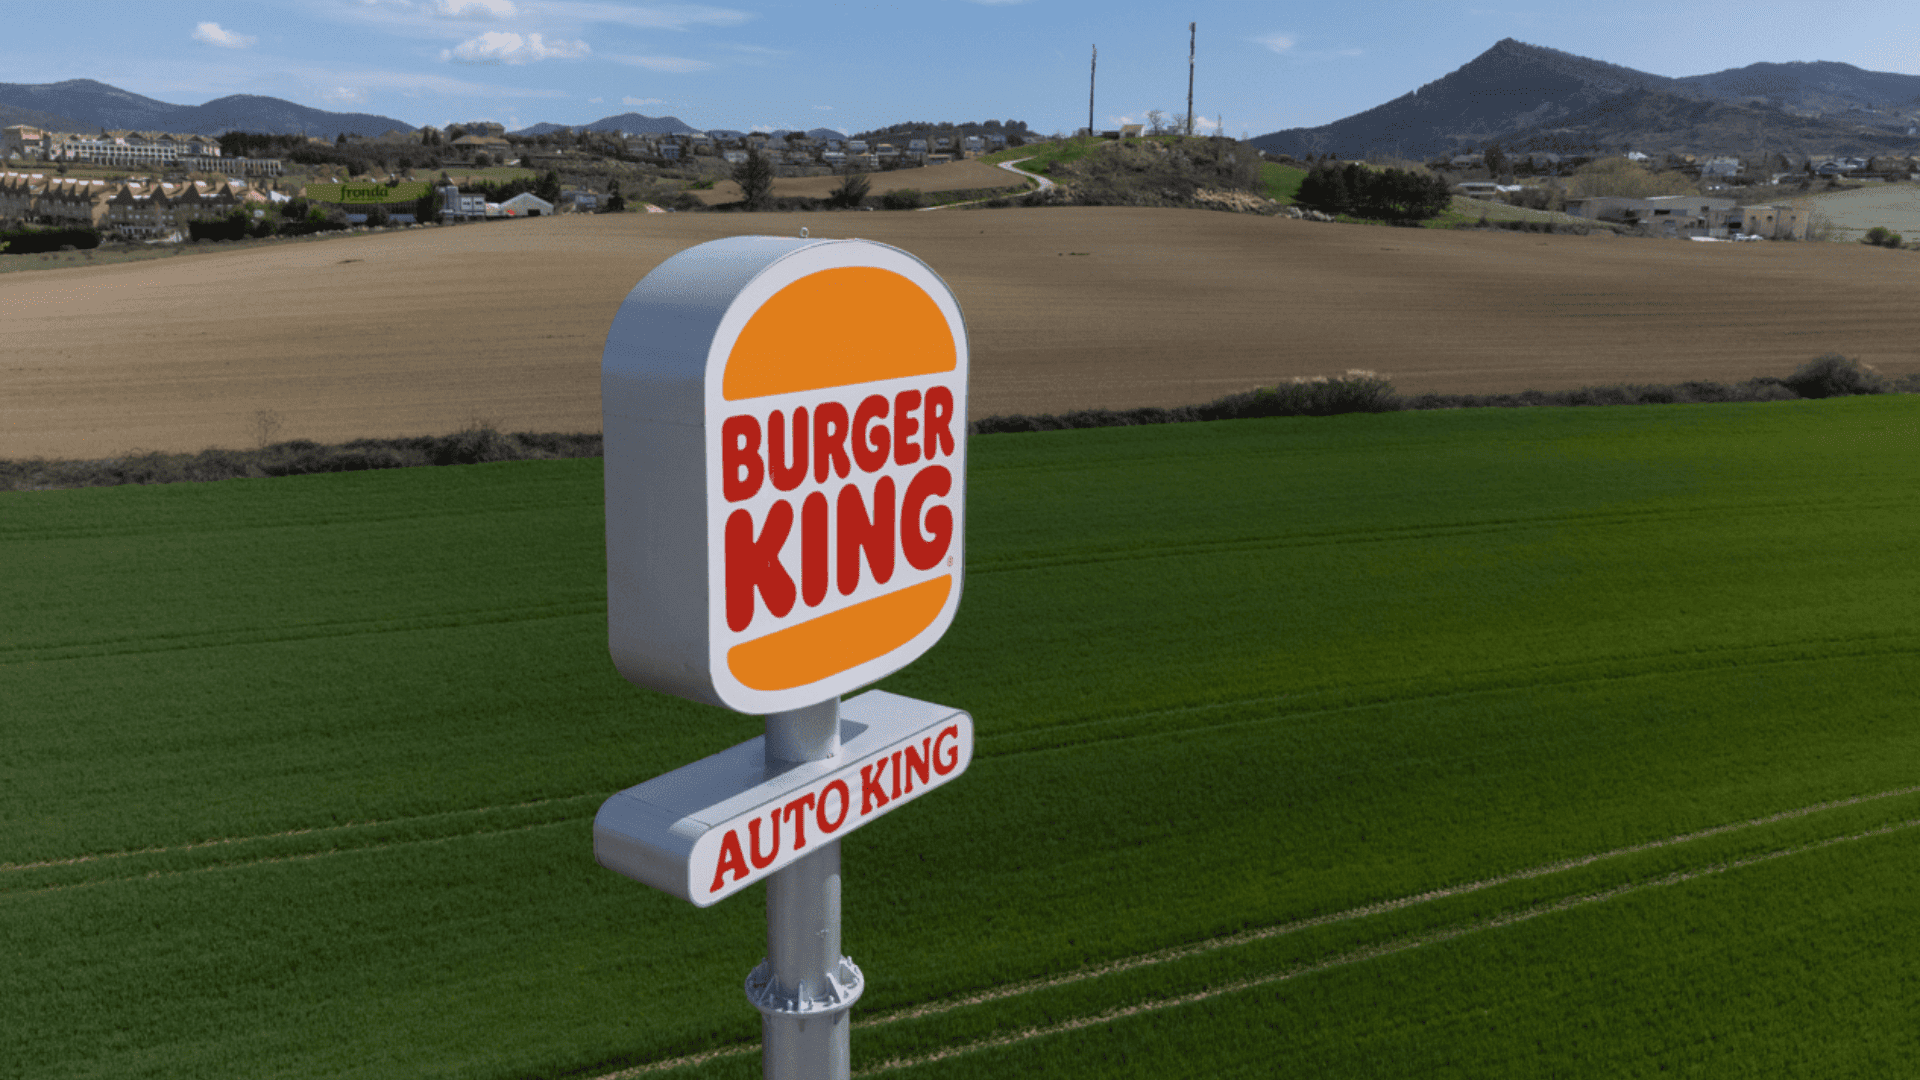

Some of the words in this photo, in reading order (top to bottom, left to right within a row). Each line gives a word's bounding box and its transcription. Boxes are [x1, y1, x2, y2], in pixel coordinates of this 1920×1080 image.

[341, 185, 388, 201] fronda
[721, 385, 955, 503] BURGER
[724, 465, 954, 633] KING
[709, 779, 850, 893] AUTO
[860, 724, 959, 816] KING
